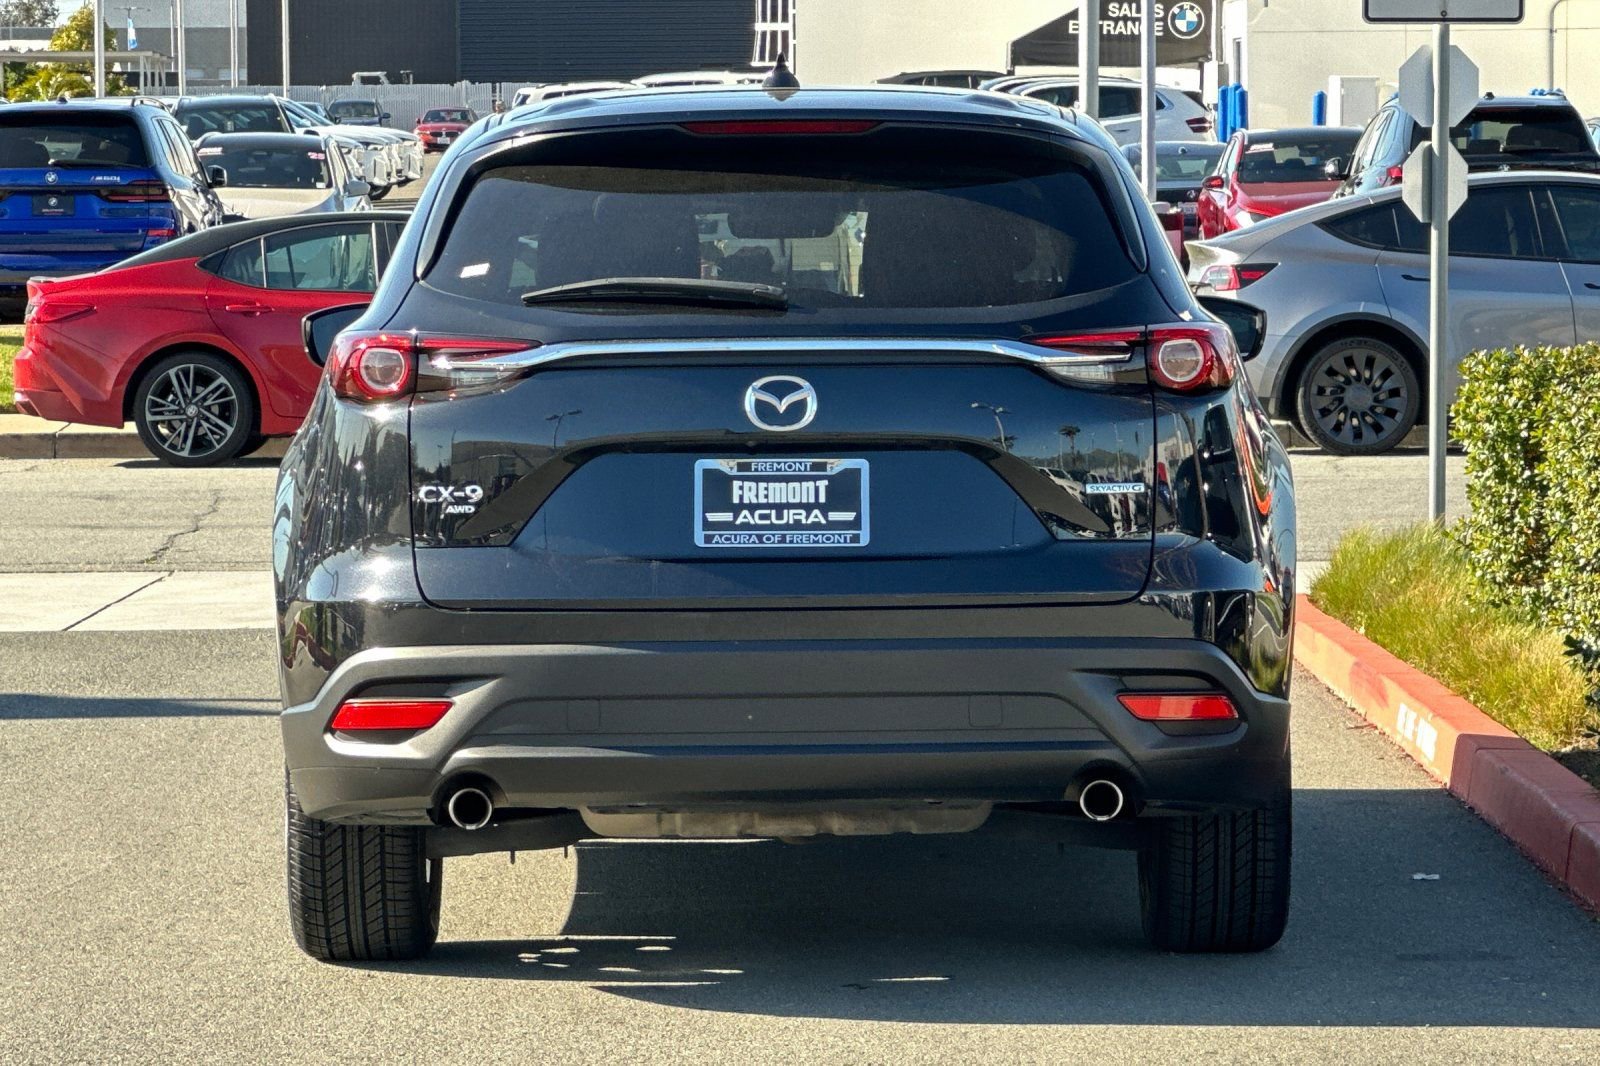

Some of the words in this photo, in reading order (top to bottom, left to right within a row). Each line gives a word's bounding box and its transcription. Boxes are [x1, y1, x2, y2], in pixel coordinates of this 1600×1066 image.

[1108, 2, 1164, 18] SALS
[1068, 20, 1164, 36] ERANE
[751, 462, 812, 472] FREMONT
[418, 485, 484, 503] CX-9
[445, 504, 476, 514] AWD
[735, 508, 827, 525] ACURA
[711, 534, 759, 545] ACURA
[762, 534, 782, 545] OF
[786, 534, 853, 545] FREMONT
